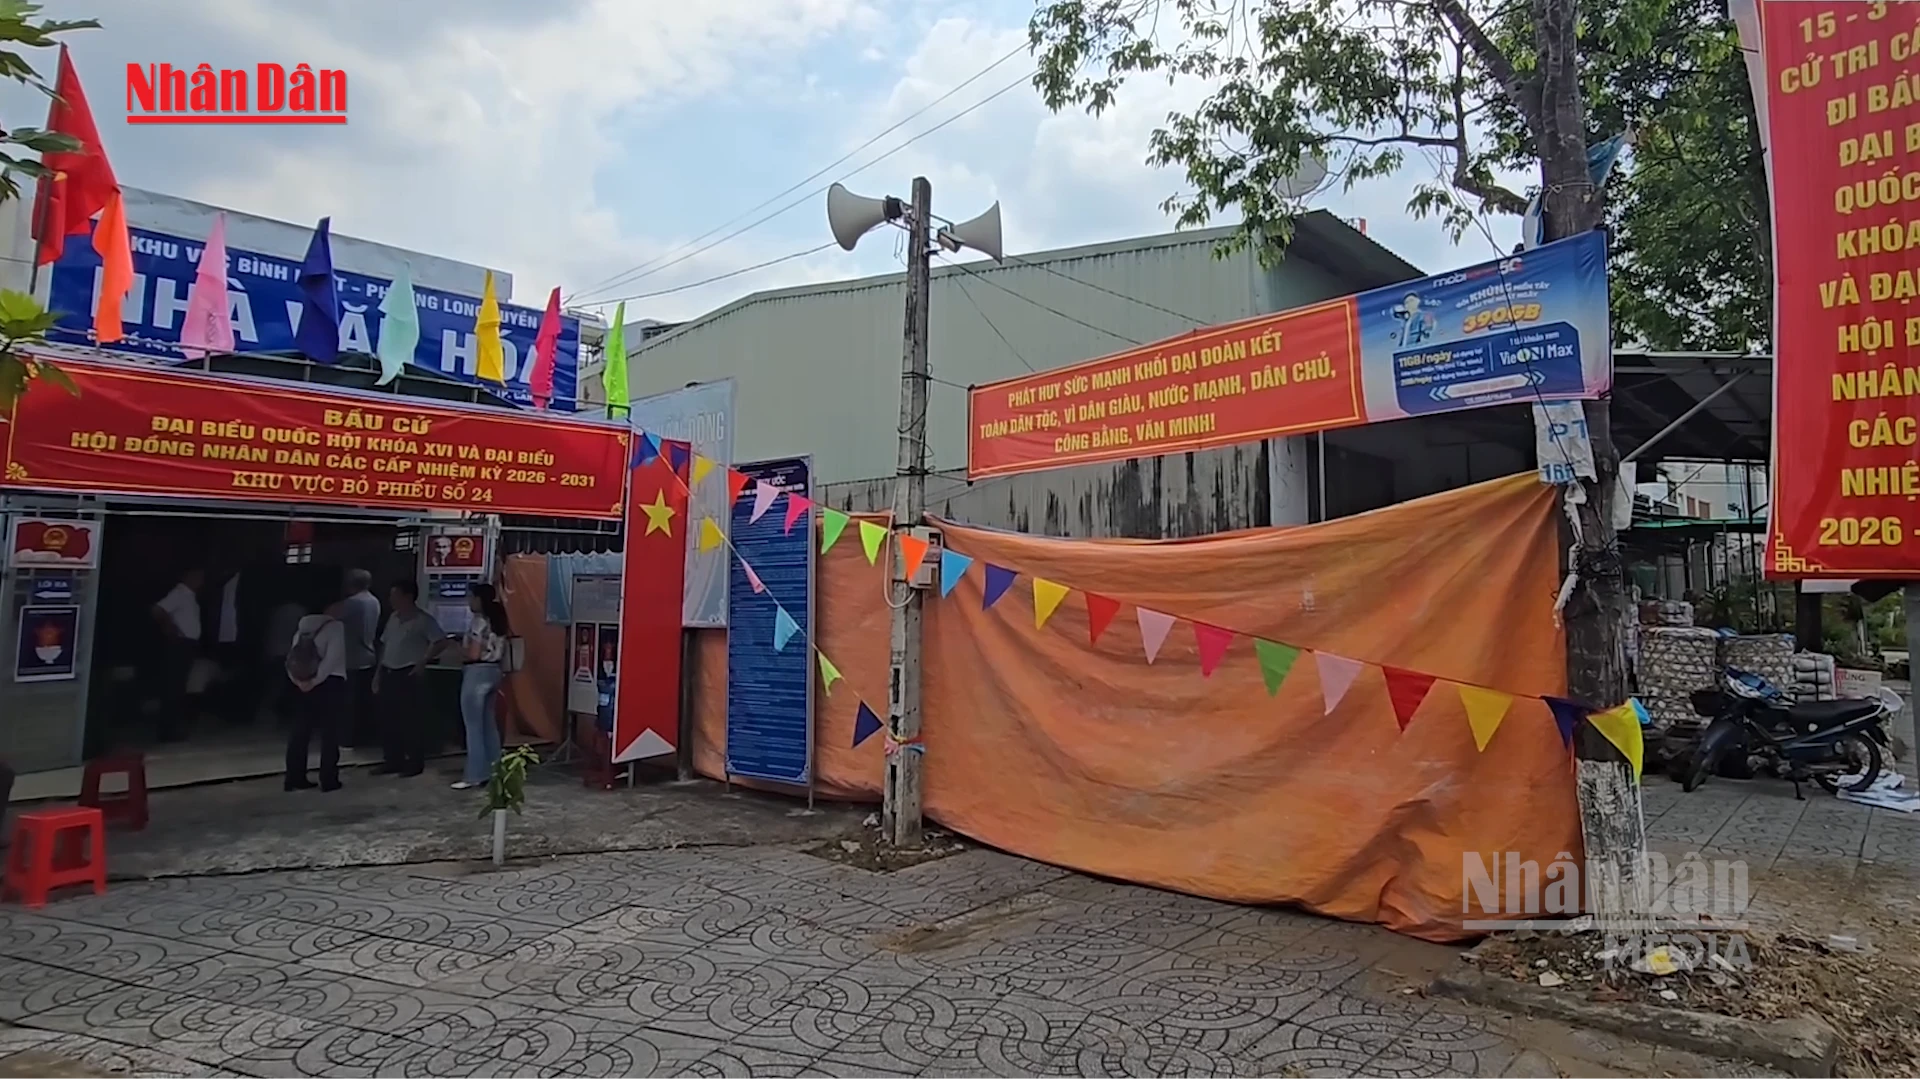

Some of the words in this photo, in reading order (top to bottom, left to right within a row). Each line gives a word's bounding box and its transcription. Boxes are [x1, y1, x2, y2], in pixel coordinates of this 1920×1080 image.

[1799, 11, 1836, 44] 15
[1780, 52, 1824, 94] CỬ
[1830, 40, 1879, 80] TRI
[1827, 93, 1857, 126] ĐI
[1839, 130, 1893, 167] ĐẠI
[1835, 165, 1920, 215] QUỐC
[131, 235, 178, 259] KHU
[237, 256, 289, 281] BÌNH
[1499, 257, 1524, 275] 5G
[1819, 272, 1860, 309] VÀ
[1463, 302, 1541, 334] 390GB
[1838, 316, 1894, 356] HỘI
[1008, 387, 1036, 408] PHÁT
[1038, 383, 1062, 401] HUY
[1064, 375, 1089, 396] SỨC
[1092, 366, 1131, 391] MẠNH
[1135, 352, 1168, 381] KHỐI
[1172, 350, 1198, 375] ĐẠI
[1201, 340, 1247, 368] ĐOÀN
[1250, 327, 1283, 357] KẾT
[1547, 343, 1574, 360] Max
[980, 420, 1008, 439] TOÀN
[1010, 414, 1033, 434] DÂN
[1036, 409, 1062, 432] TỘC,
[1064, 404, 1076, 425] VÌ
[1079, 400, 1106, 421] DÂN
[1109, 393, 1145, 416] GIÀU,
[1148, 383, 1189, 410] NƯỚC
[1193, 375, 1247, 402] MẠNH,
[1250, 364, 1288, 392] DÂN
[1292, 350, 1337, 383] CHỦ,
[1832, 362, 1920, 402] NHÂN
[152, 415, 194, 437] ĐẠI
[201, 418, 255, 440] BIỂU
[262, 426, 320, 446] QUỐC
[326, 432, 361, 451] HỘI
[367, 437, 418, 455] KHÓA
[424, 442, 453, 458] XVI
[458, 443, 480, 460] VÀ
[484, 448, 513, 465] ĐẠI
[518, 448, 554, 466] BIỂU
[323, 408, 384, 431] BẦU
[392, 415, 433, 435] CỬ
[1055, 431, 1089, 454] CÔNG
[1092, 424, 1133, 447] BẰNG,
[1136, 419, 1165, 442] VĂN
[1169, 412, 1216, 438] MINH!
[1848, 411, 1917, 449] CÁC
[71, 431, 117, 453] HỘI
[124, 435, 195, 457] ĐỒNG
[202, 444, 268, 463] NHÂN
[274, 449, 320, 468] DÂN
[326, 454, 367, 472] CÁC
[372, 454, 412, 473] CẤP
[416, 461, 475, 481] NHIỆM
[480, 465, 503, 481] KỲ
[506, 469, 546, 484] 2026
[560, 473, 595, 488] 2031
[232, 470, 283, 489] KHU
[289, 473, 335, 495] VỰC
[341, 475, 369, 495] BỎ
[376, 478, 437, 499] PHIẾU
[442, 480, 467, 500] SỐ
[471, 487, 493, 502] 24
[1819, 516, 1902, 546] 2026
